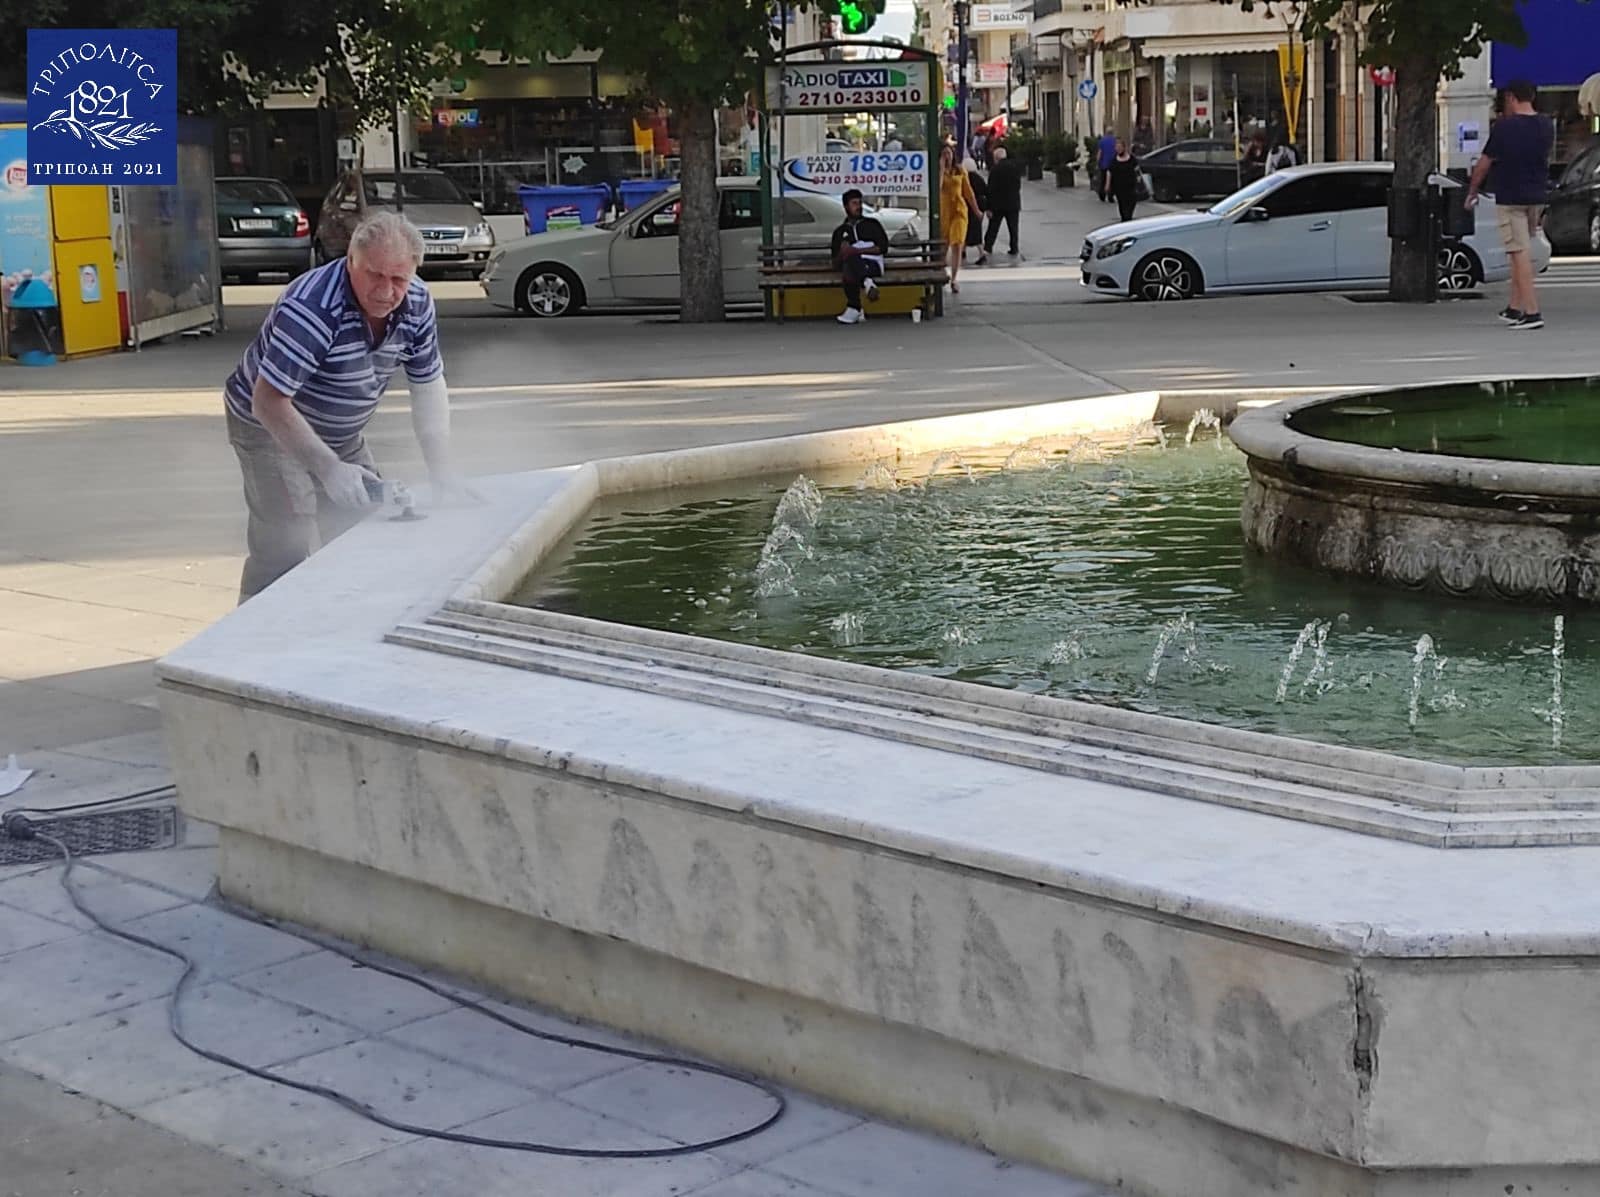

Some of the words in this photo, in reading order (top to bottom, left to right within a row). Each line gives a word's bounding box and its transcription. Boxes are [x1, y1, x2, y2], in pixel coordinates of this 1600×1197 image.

[839, 71, 884, 86] TAXI
[807, 163, 841, 173] TAXI
[872, 184, 922, 193] ΤΡΙΠΟΛΗΣ
